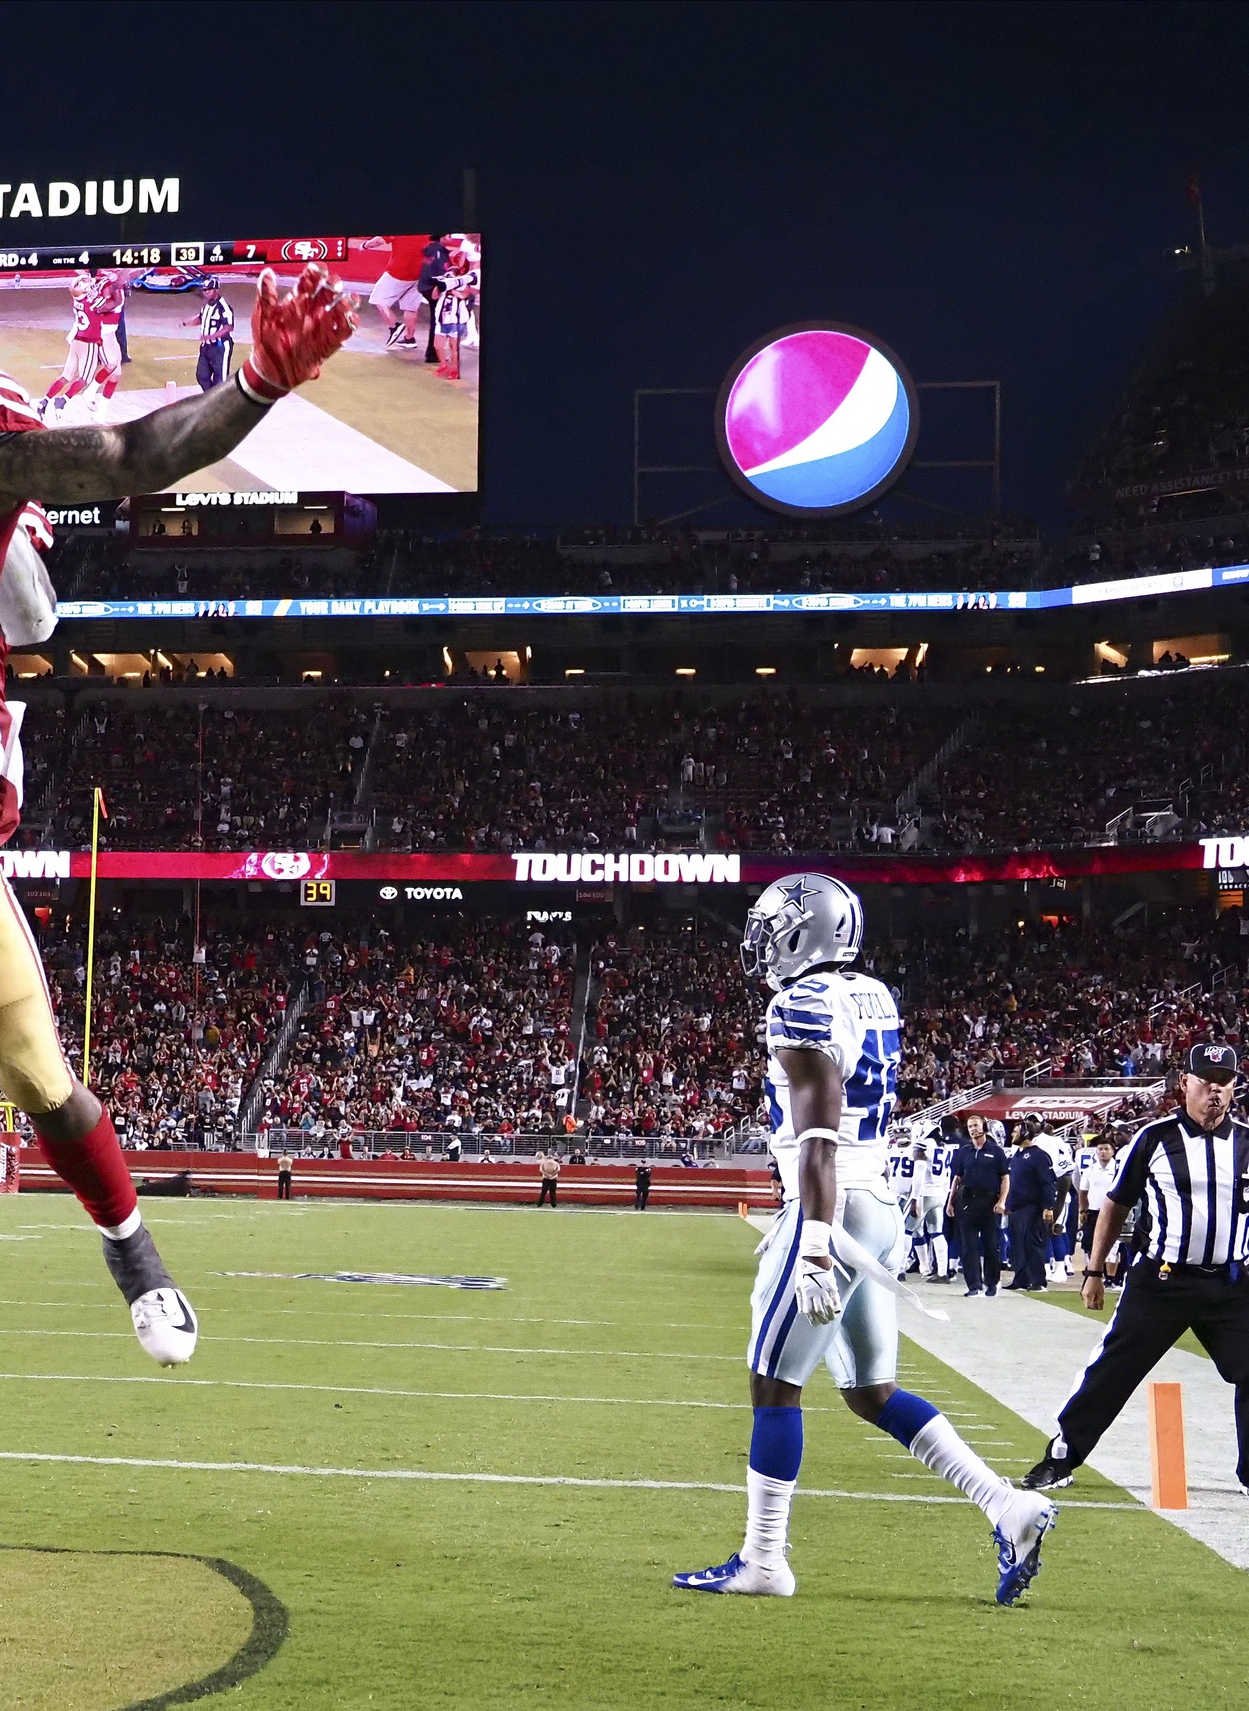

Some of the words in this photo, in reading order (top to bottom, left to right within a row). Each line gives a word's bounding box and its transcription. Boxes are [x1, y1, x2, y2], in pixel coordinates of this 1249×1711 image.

[113, 248, 161, 265] 14:18
[179, 248, 196, 261] 39
[212, 244, 222, 256] 4
[246, 245, 256, 258] 7
[28, 253, 38, 266] 4
[79, 251, 90, 265] 4
[233, 491, 298, 505] STADIUM
[511, 853, 741, 882] TOUCHDOWN
[307, 882, 331, 901] 39
[405, 887, 463, 900] TOYOTA
[1043, 1111, 1084, 1120] STADIUM
[890, 1156, 914, 1178] 79
